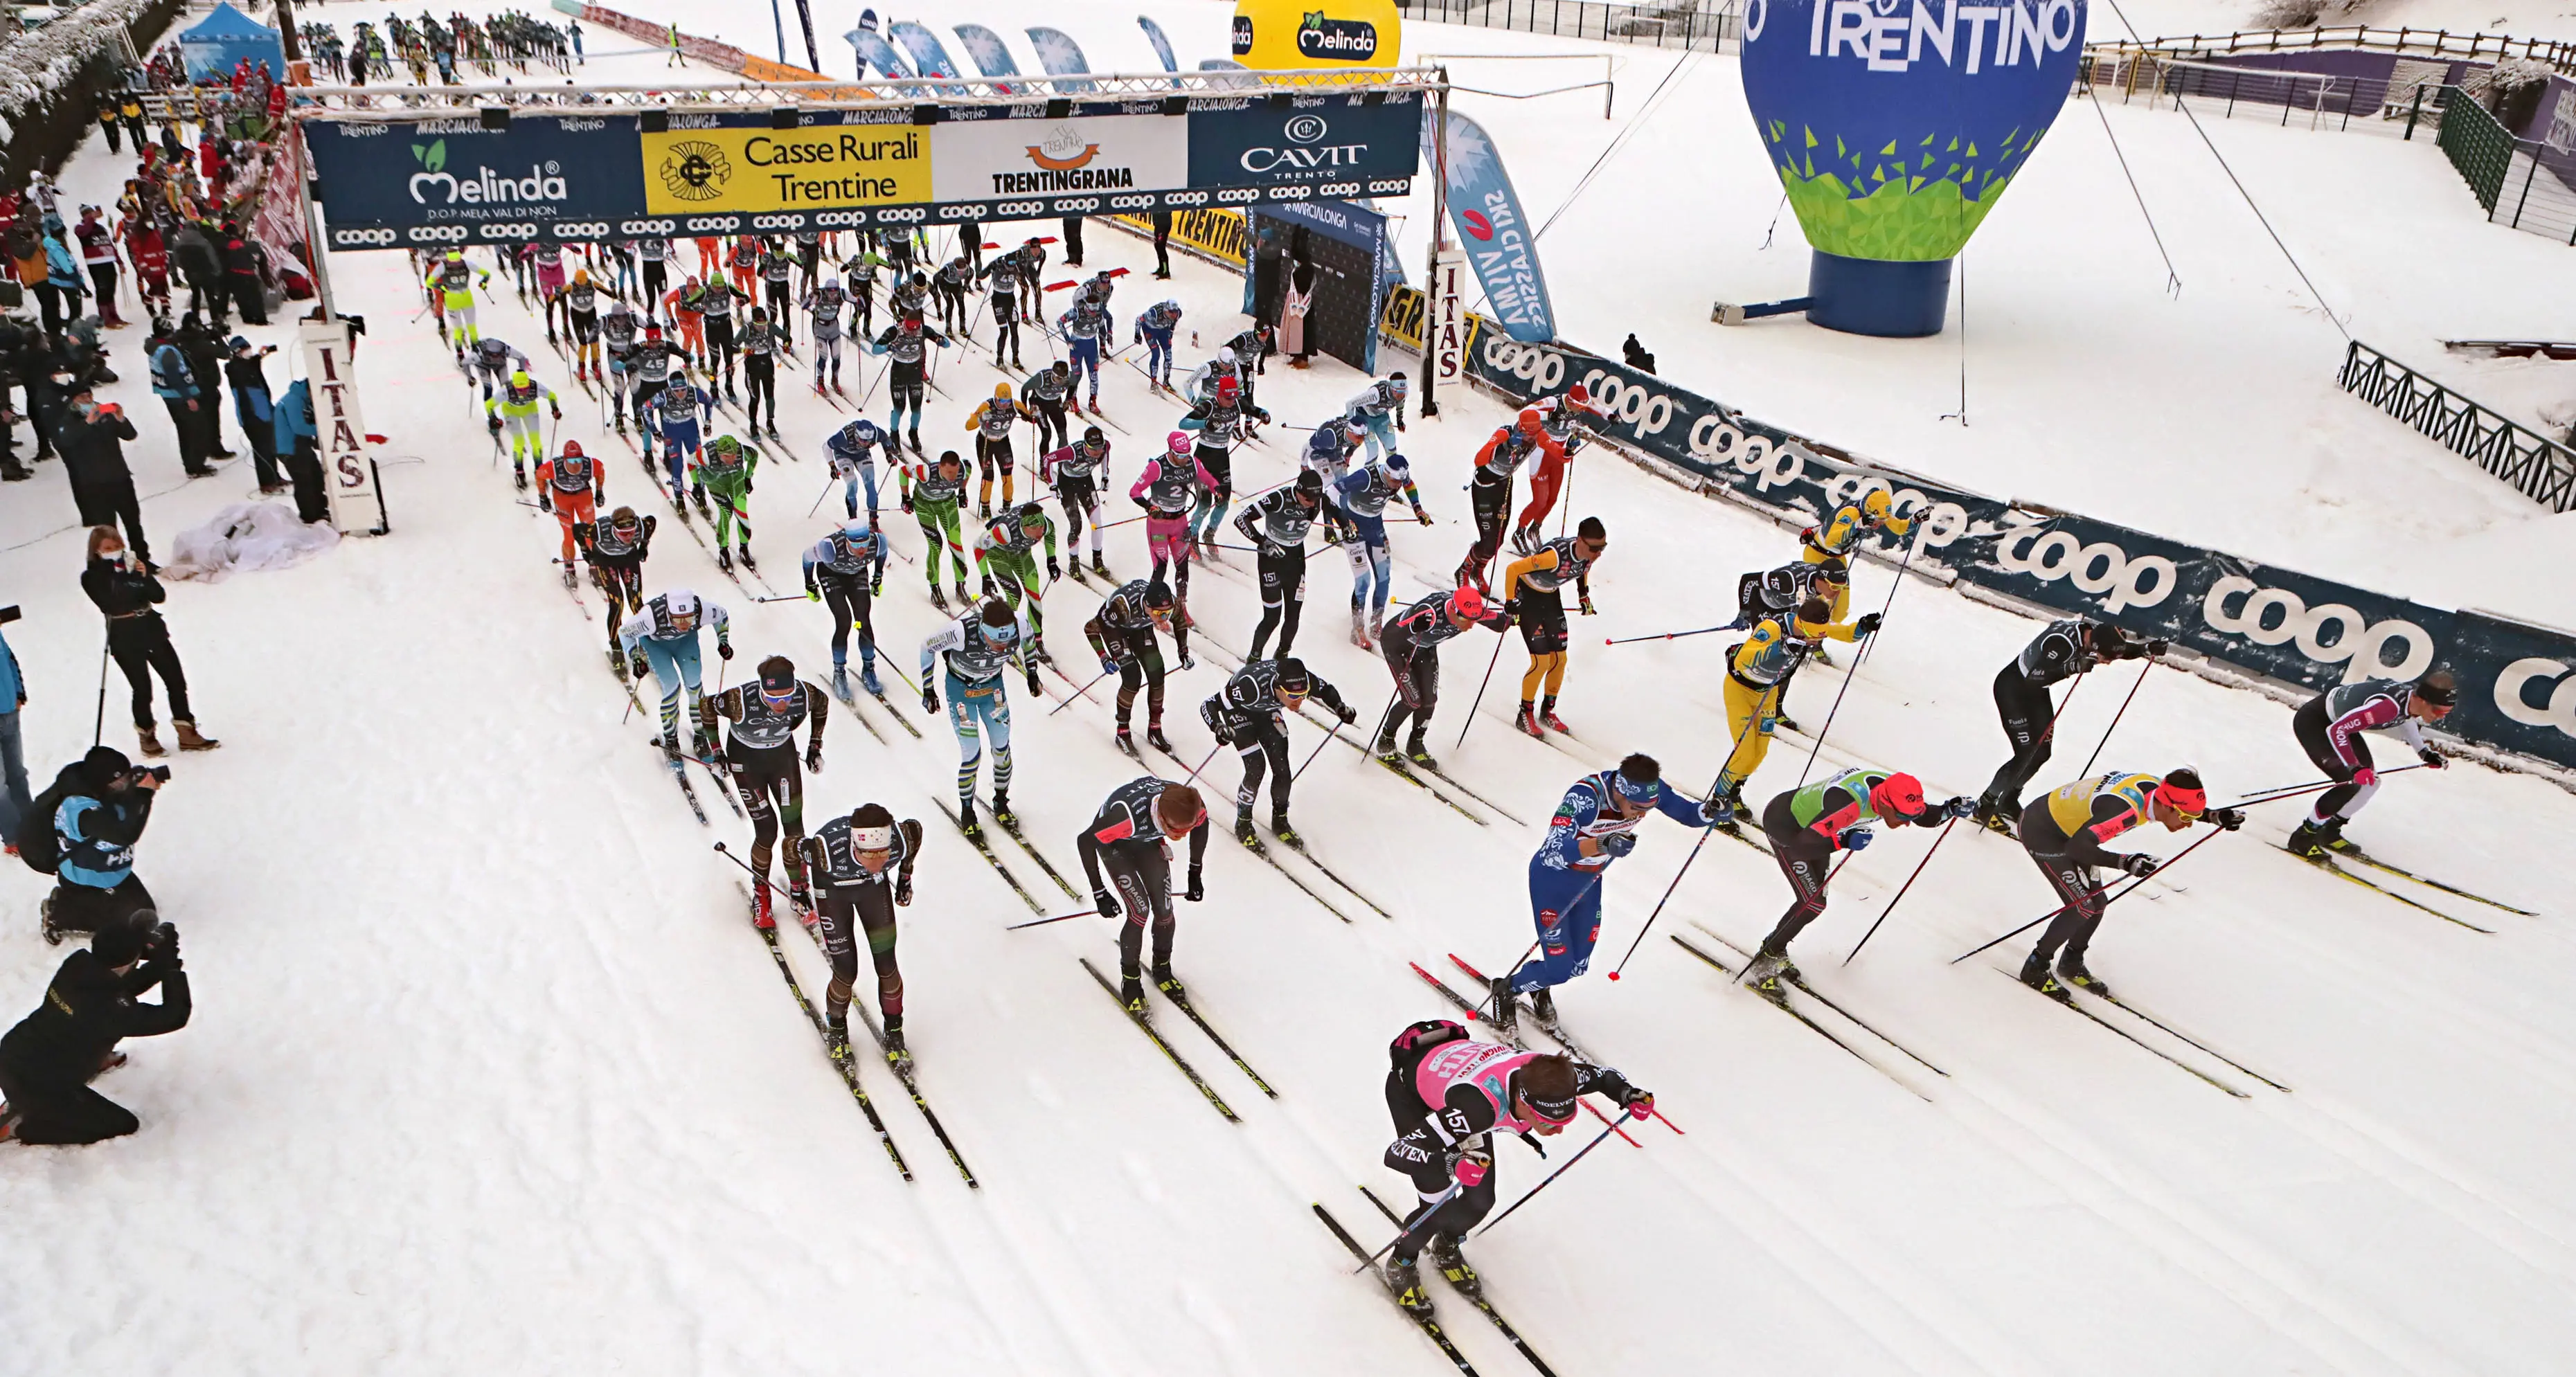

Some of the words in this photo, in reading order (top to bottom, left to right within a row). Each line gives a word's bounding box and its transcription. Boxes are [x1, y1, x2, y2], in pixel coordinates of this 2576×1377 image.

[1300, 28, 1374, 51] Melinda
[1122, 102, 1159, 115] TRENTINO
[1292, 96, 1325, 109] TRENTINO
[842, 109, 913, 125] MARCIALONG
[949, 108, 987, 122] TRENTINO
[338, 124, 388, 138] TRENTINO
[559, 118, 605, 132] TRENTINO
[744, 136, 834, 167] Casse
[840, 133, 918, 163] Rurali
[1241, 144, 1368, 172] CAVIT
[992, 168, 1134, 194] TRENTINGRANA
[1274, 170, 1336, 180] TRENTO
[409, 164, 567, 204] Melinda
[771, 173, 897, 201] Trentine
[1320, 182, 1361, 199] coop
[1368, 179, 1409, 195] coop
[1165, 190, 1208, 208] coop
[1217, 188, 1260, 204] coop
[1269, 185, 1311, 201] coop
[997, 201, 1044, 218] coop
[1054, 196, 1100, 213] coop
[1111, 194, 1155, 210] coop
[461, 208, 490, 219] MELA
[492, 208, 512, 218] VAL
[515, 207, 527, 217] DI
[529, 206, 557, 217] NON
[816, 210, 866, 228] coop
[877, 208, 926, 224] coop
[939, 204, 987, 221] coop
[1292, 204, 1348, 231] MARCIALONGA
[553, 222, 610, 239] coop
[621, 219, 676, 236] coop
[687, 216, 740, 233] coop
[753, 213, 805, 231] coop
[335, 228, 397, 246] coop
[409, 225, 468, 242] coop
[480, 222, 538, 240] coop
[1369, 238, 1382, 329] MARCIALONGA
[1439, 268, 1459, 378] ITAS
[645, 359, 665, 369] 45
[1483, 336, 1565, 395] coop
[1583, 369, 1672, 440] coop
[319, 348, 364, 488] ITAS
[992, 420, 1010, 430] 36
[1215, 421, 1237, 433] 27
[1689, 415, 1804, 492] coop
[1170, 485, 1183, 498] 2
[1996, 526, 2176, 615] coop
[1771, 577, 1780, 591] 157
[2203, 575, 2434, 685] coop
[1232, 685, 1245, 702] 157
[1803, 873, 1819, 894] RAGD
[1129, 886, 1148, 912] RAGDE
[1233, 1059, 1270, 1092] FISCHER
[1535, 1096, 1575, 1108] MOELVEN
[1445, 1108, 1472, 1135] 157
